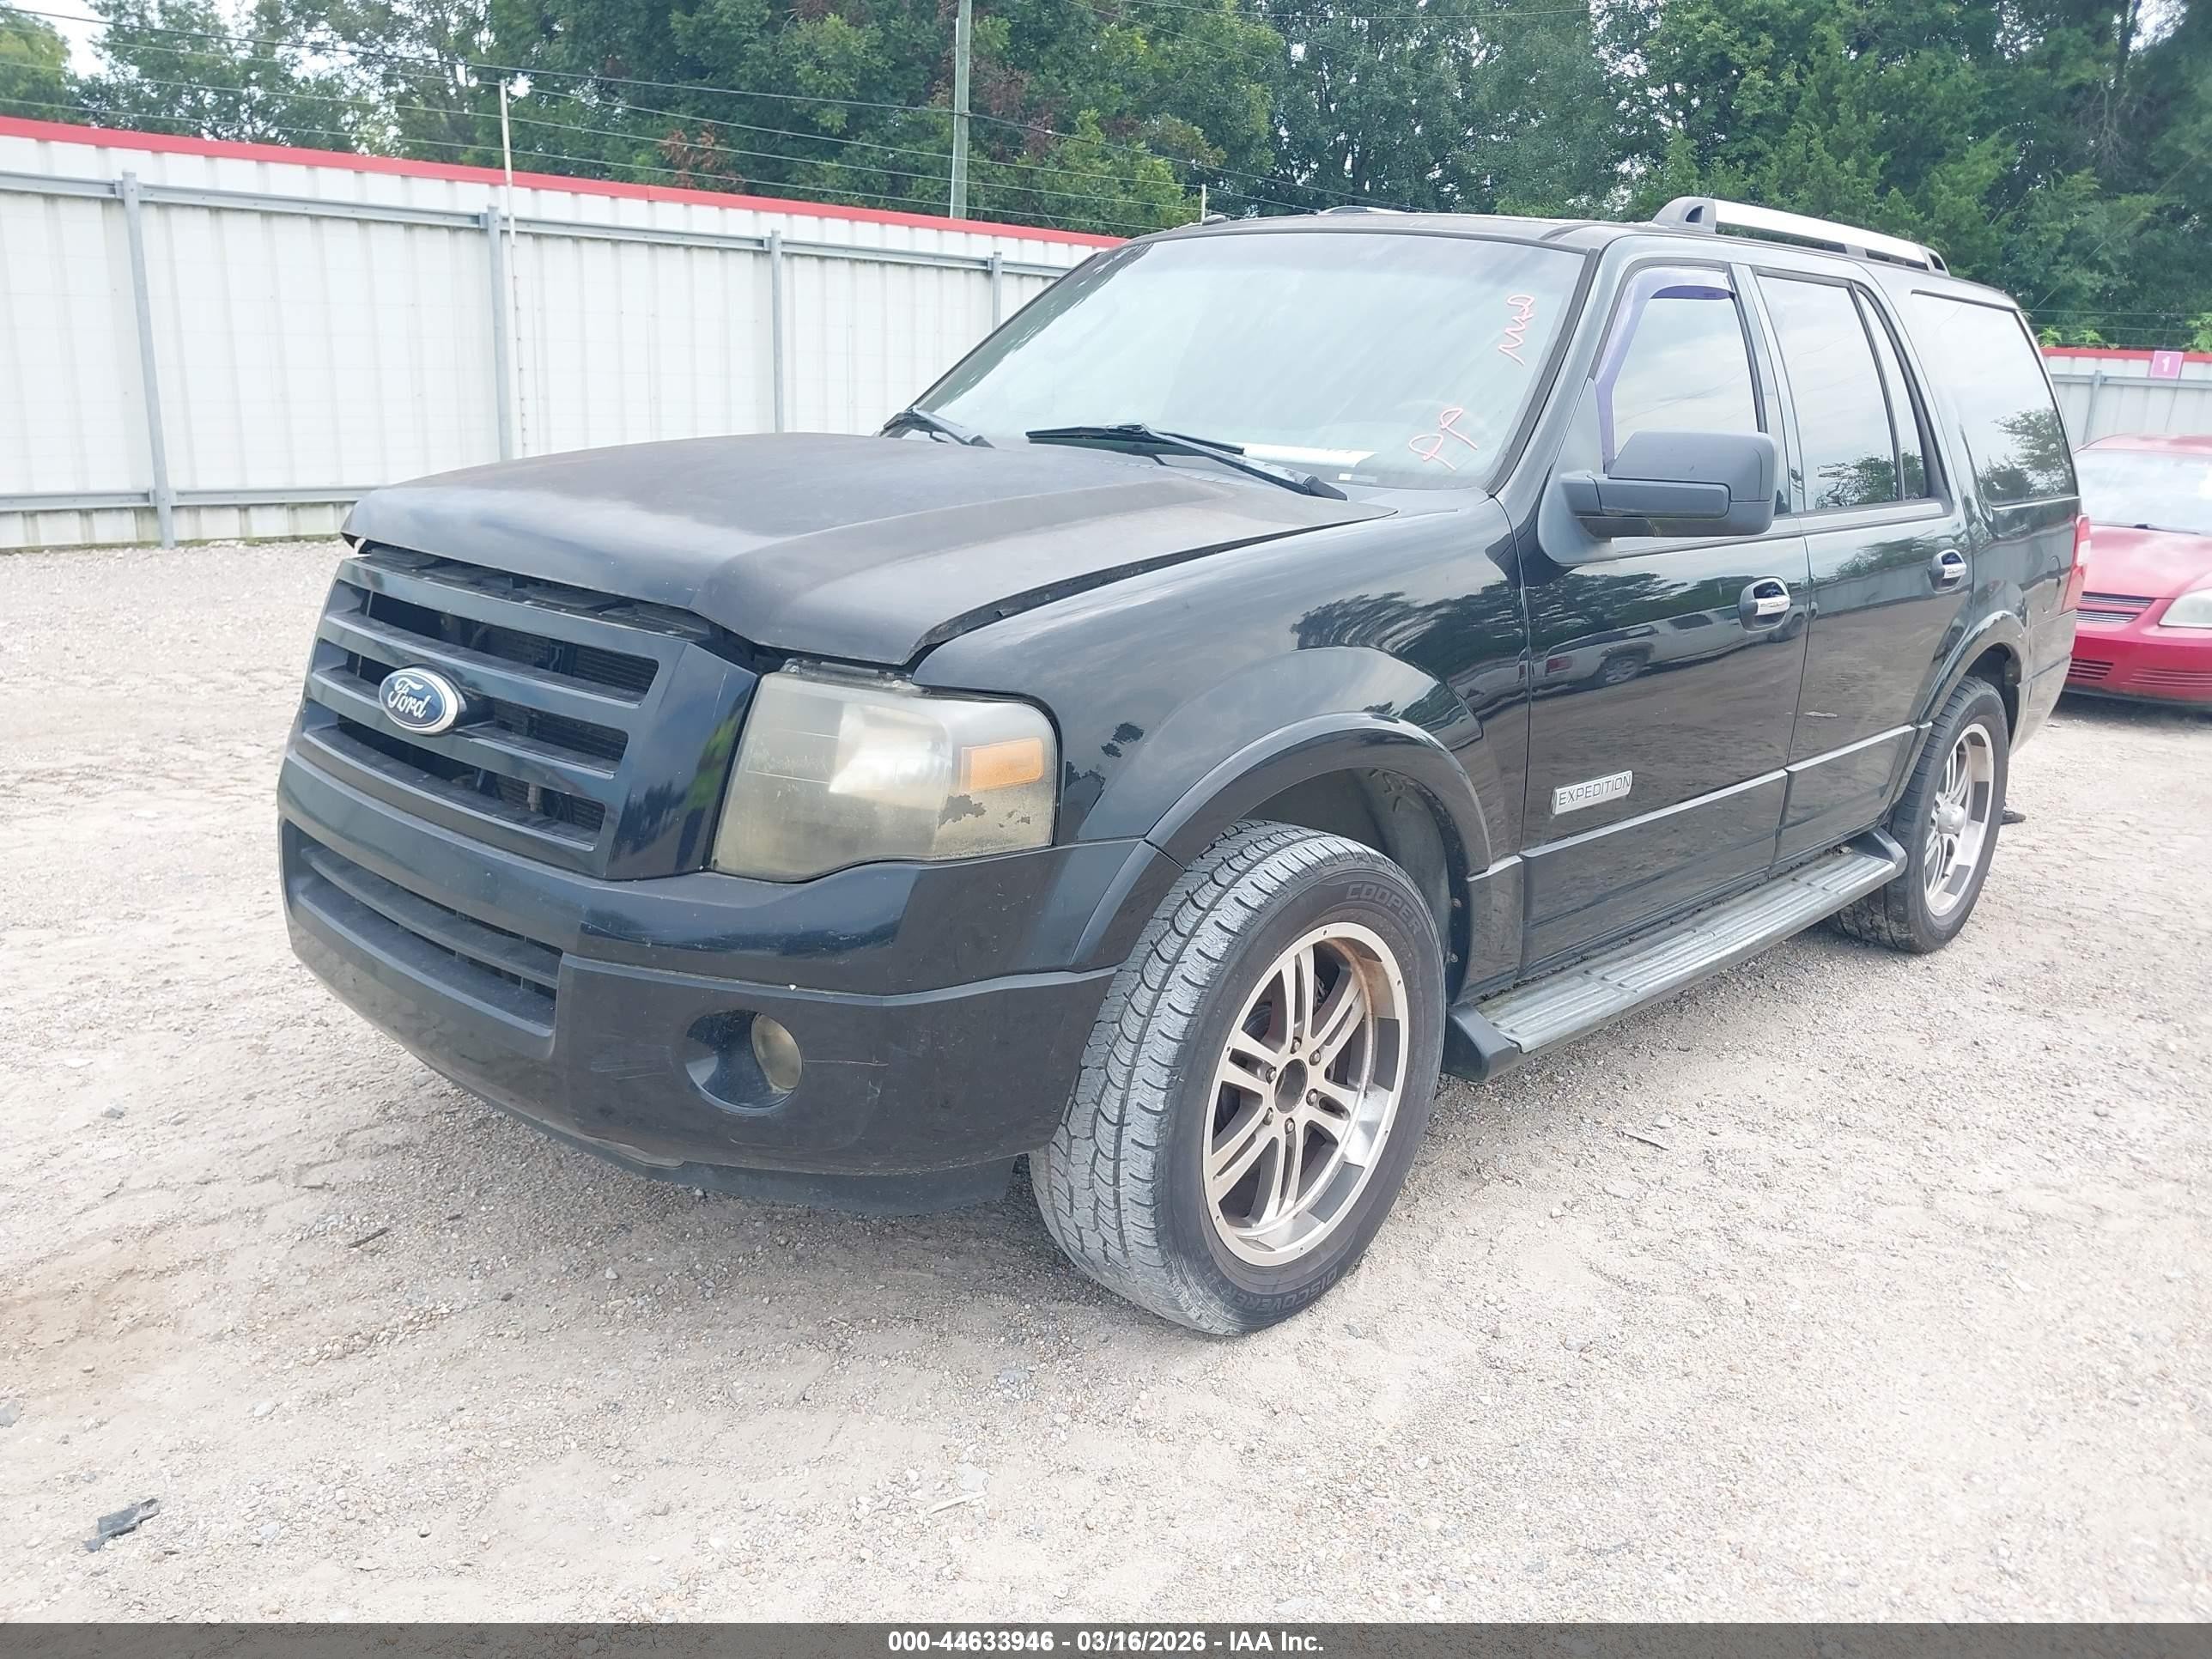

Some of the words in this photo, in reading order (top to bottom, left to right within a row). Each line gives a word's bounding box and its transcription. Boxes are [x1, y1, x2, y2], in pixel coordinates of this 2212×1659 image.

[2162, 356, 2171, 372] 1
[387, 677, 432, 719] Ford
[1559, 775, 1631, 805] EXPEDITION
[1346, 883, 1422, 936] COOPER
